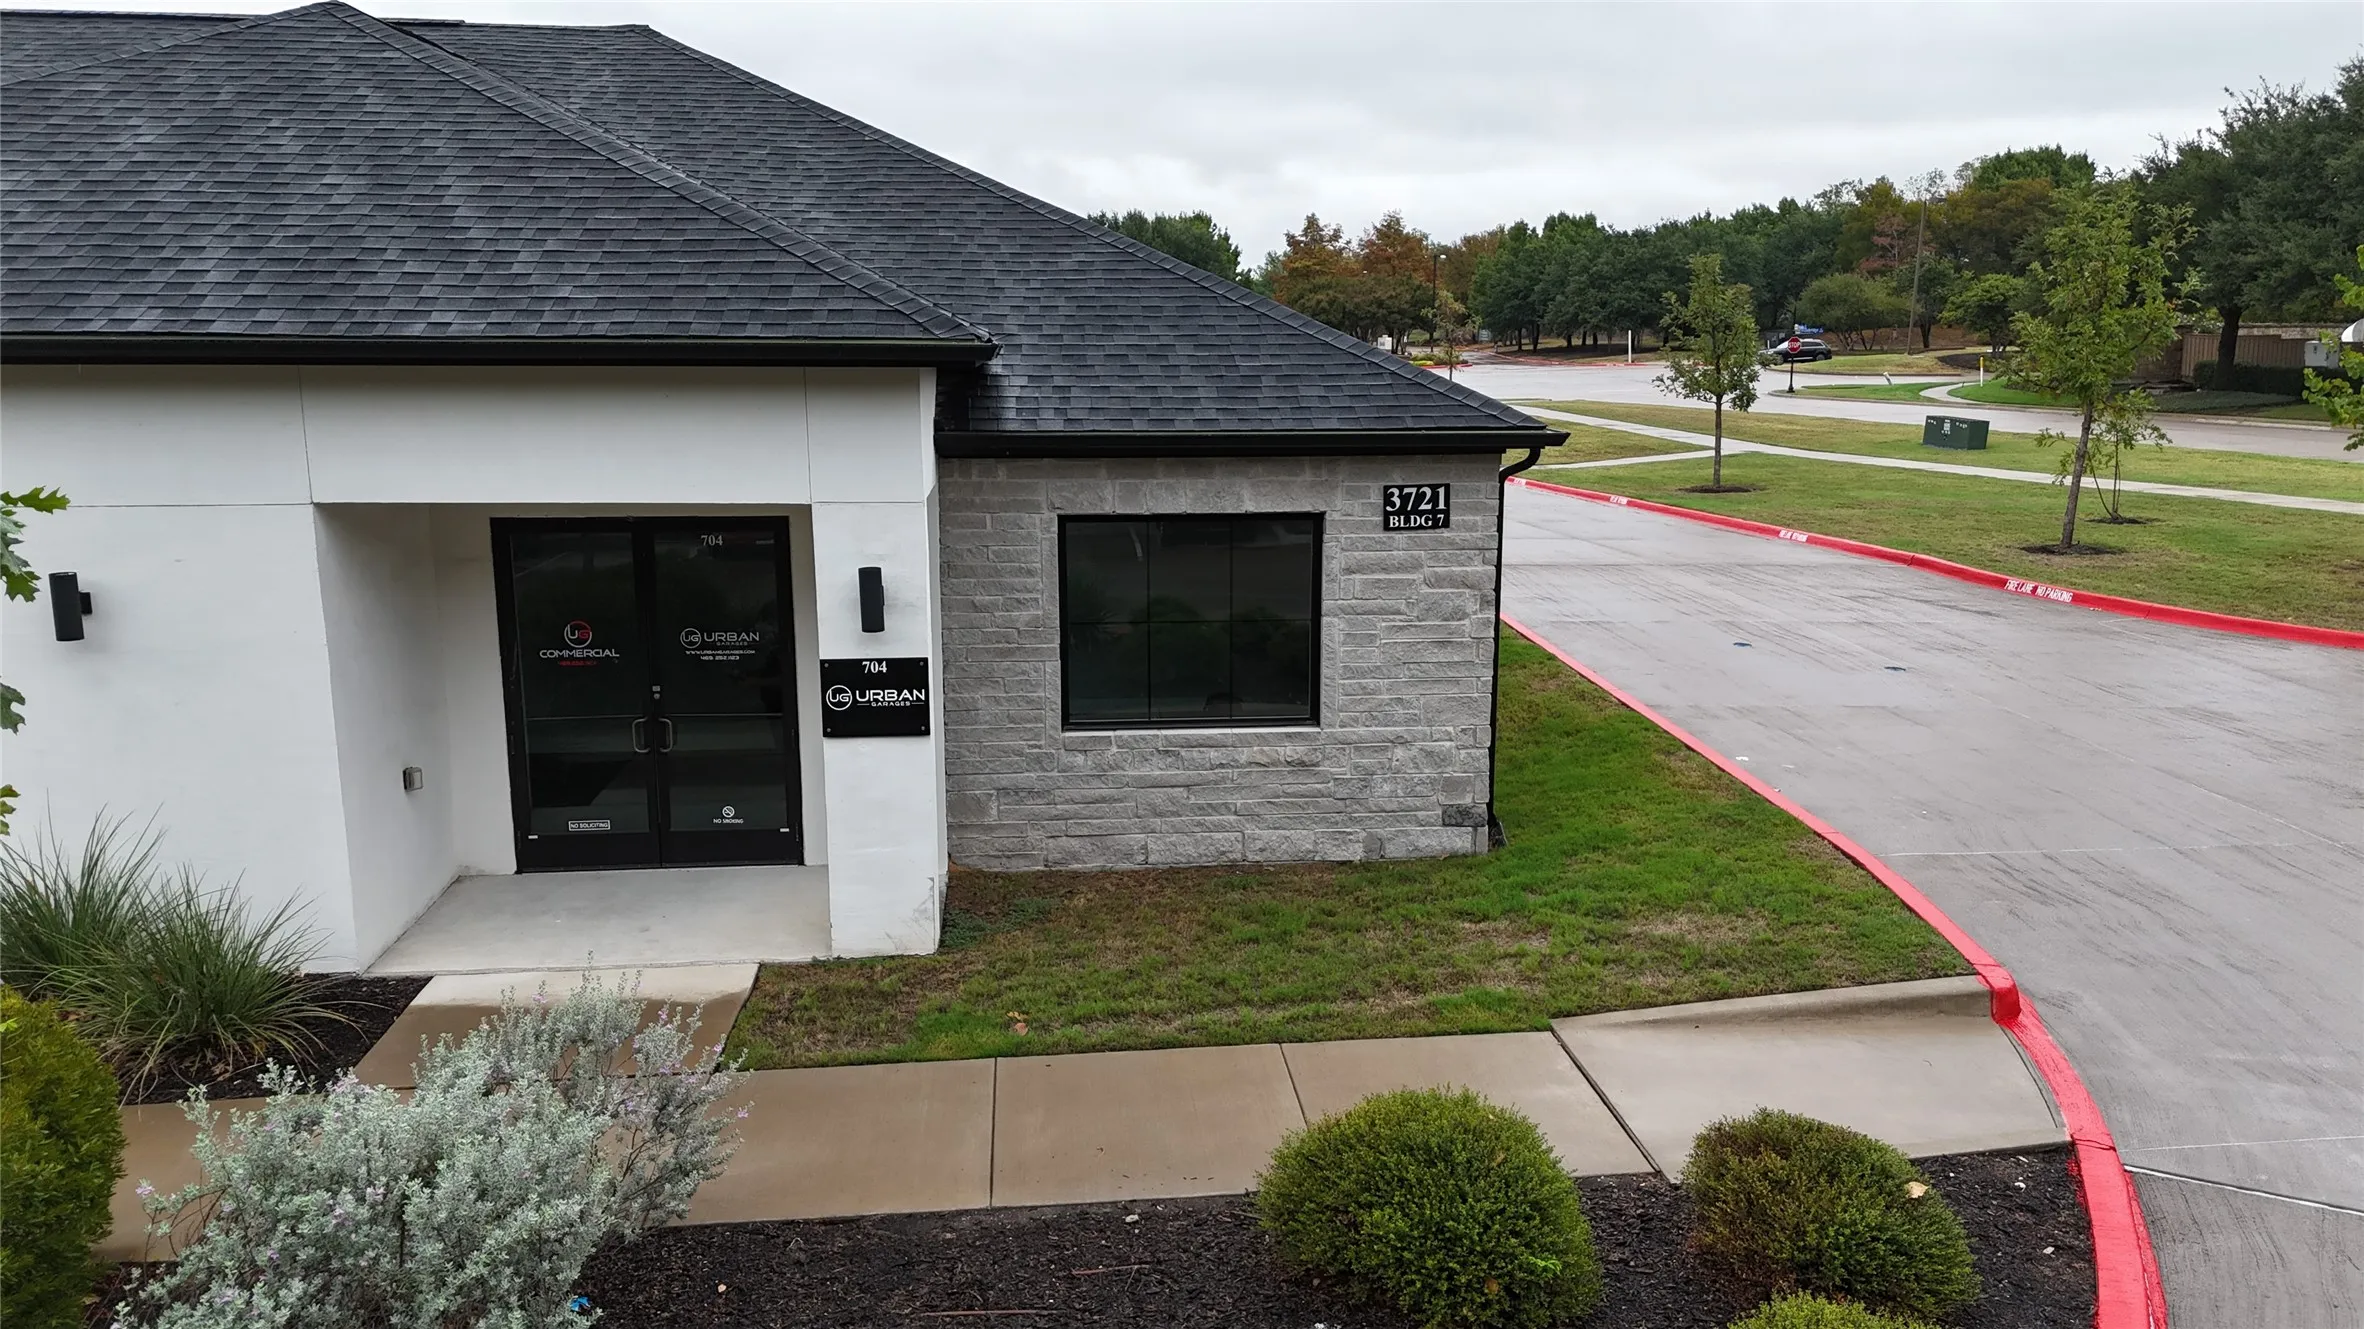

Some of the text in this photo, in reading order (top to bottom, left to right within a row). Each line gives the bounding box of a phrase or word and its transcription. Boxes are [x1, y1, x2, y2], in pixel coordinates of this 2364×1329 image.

[1385, 486, 1447, 511] 3721
[1389, 514, 1445, 528] BLDG 7
[700, 534, 723, 546] 704
[2004, 580, 2073, 602] FIRE LANE NO PARKING
[566, 623, 591, 642] UG
[682, 630, 759, 644] UG URBAN
[539, 649, 620, 658] COMMERCIAL
[862, 660, 887, 673] 704
[828, 687, 925, 704] UG URBAN
